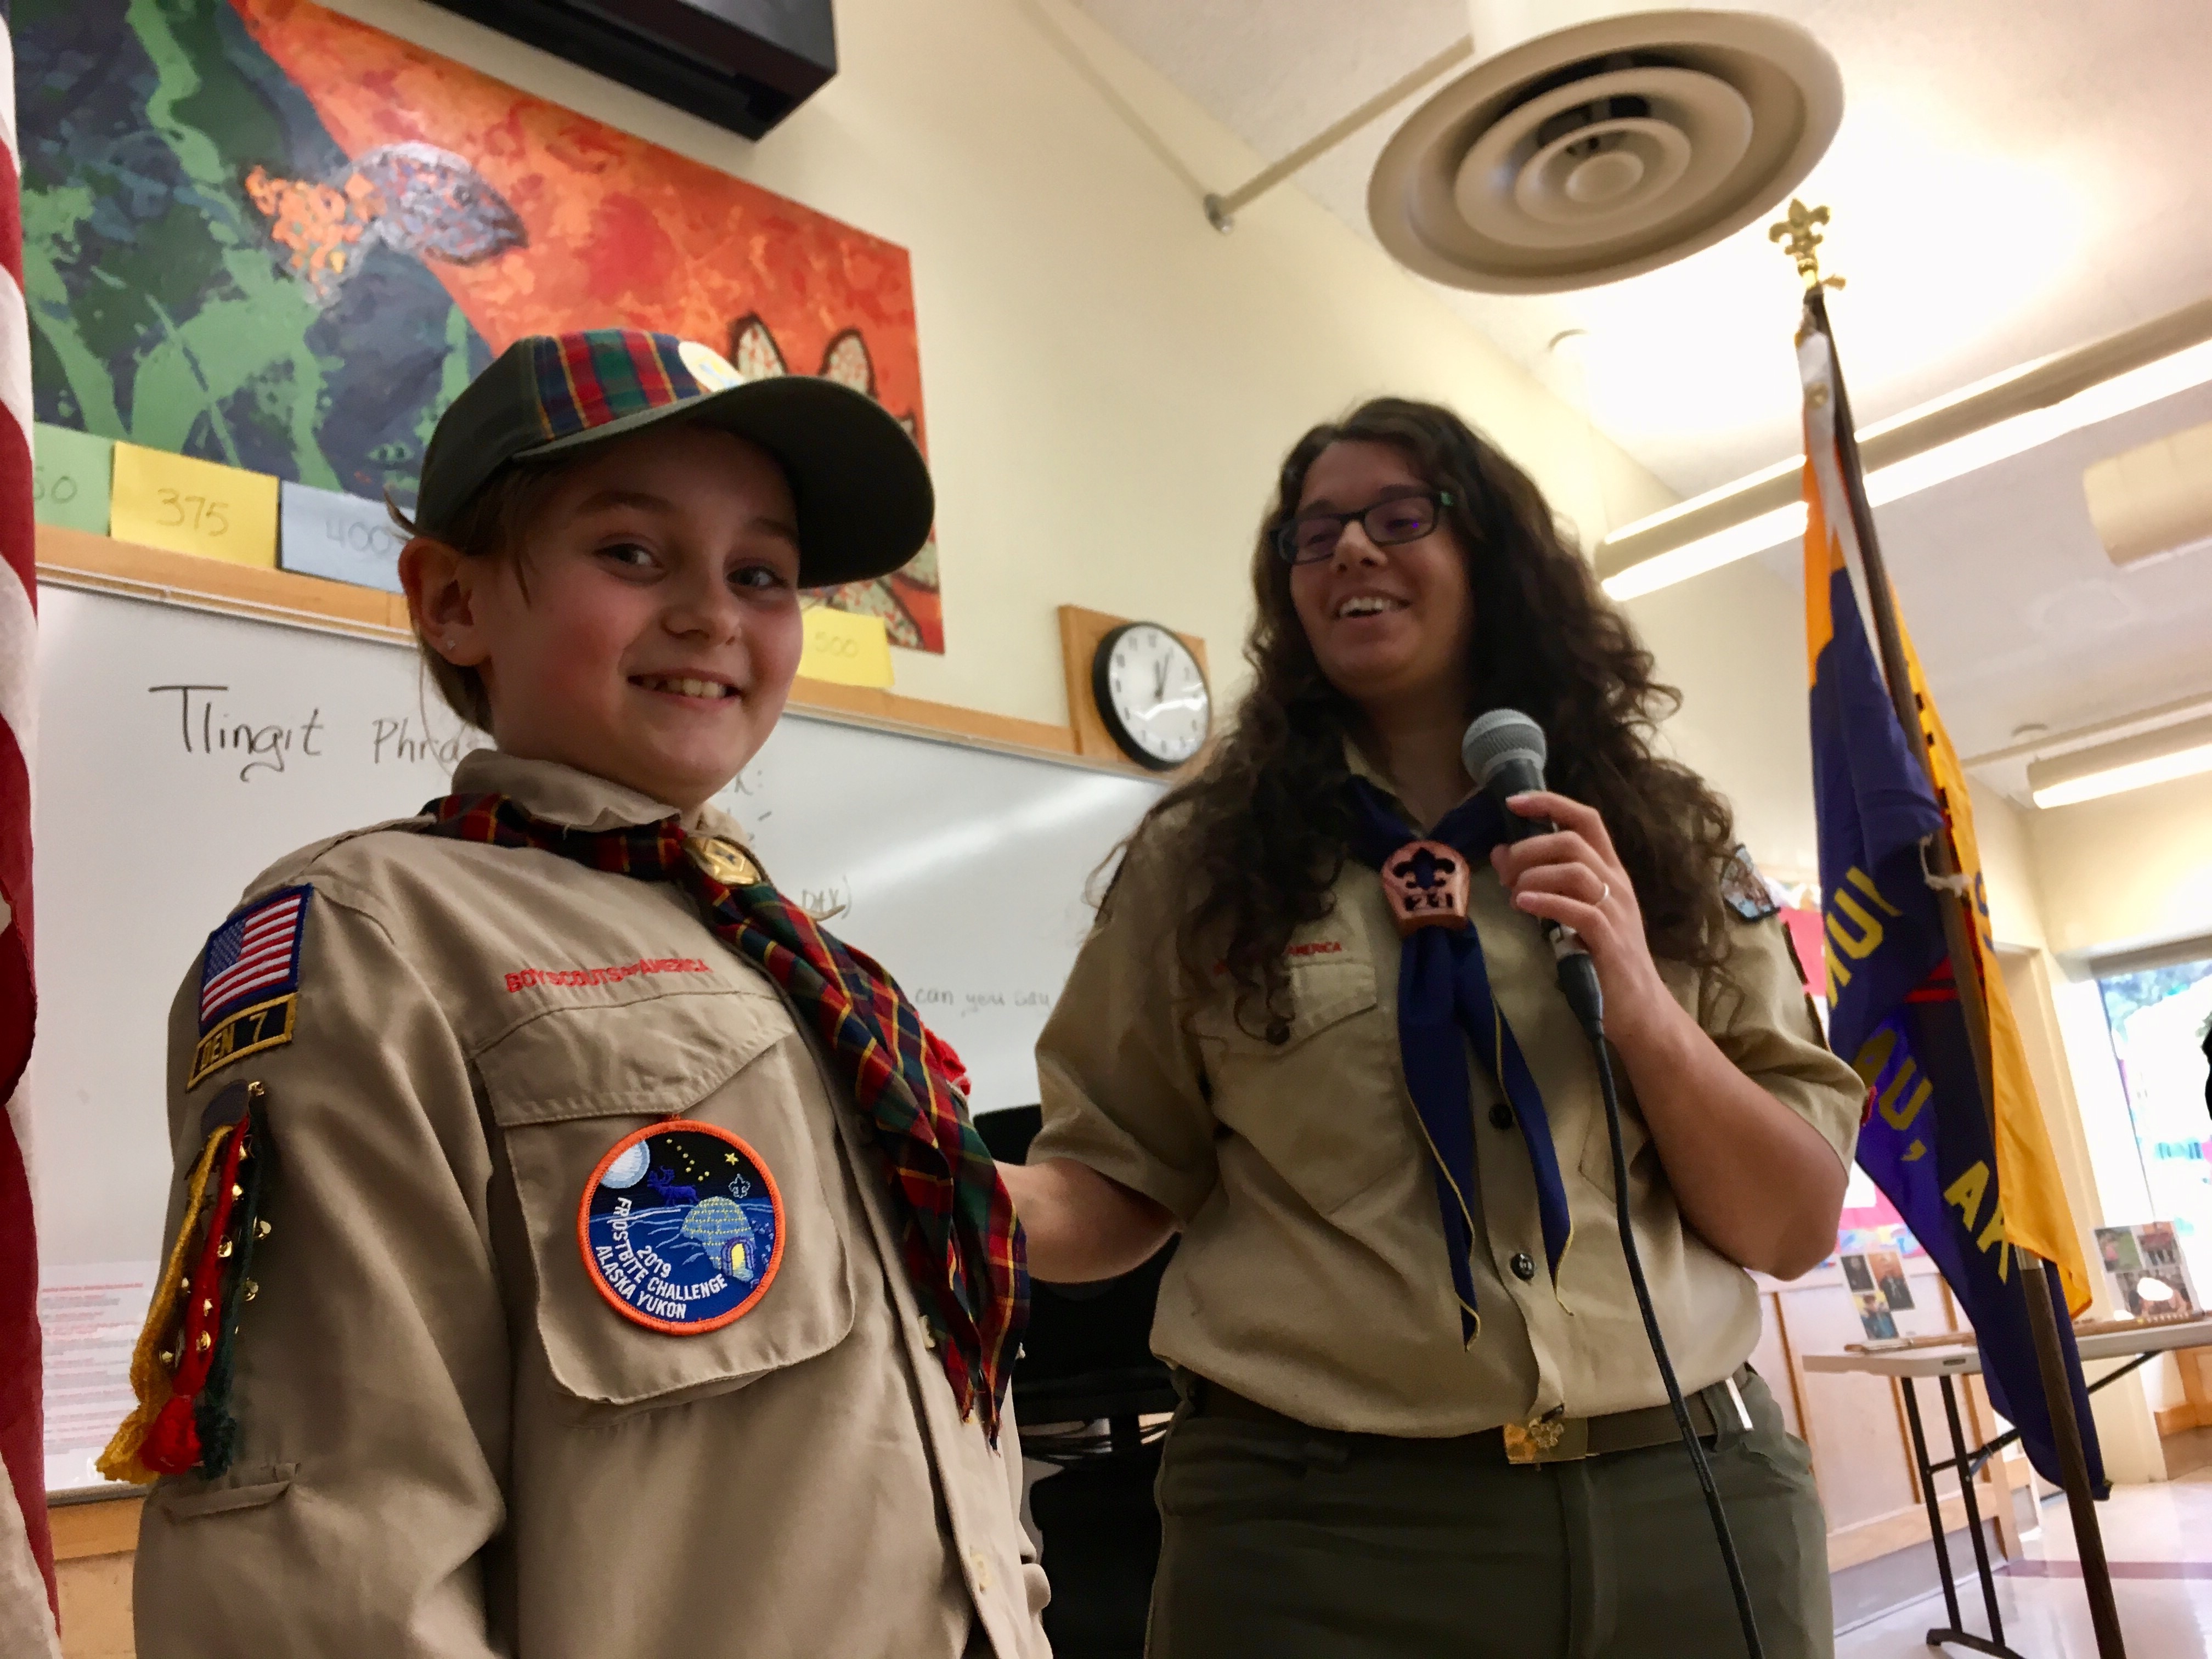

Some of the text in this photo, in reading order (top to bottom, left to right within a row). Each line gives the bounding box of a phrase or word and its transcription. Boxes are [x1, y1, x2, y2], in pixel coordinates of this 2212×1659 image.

[156, 488, 229, 536] 375
[326, 520, 392, 555] 400
[815, 631, 860, 658] 500
[148, 684, 481, 783] Tlingit Phra
[504, 968, 545, 992] BOY
[545, 966, 624, 987] SCOUTS
[915, 988, 954, 1006] can
[961, 992, 1005, 1018] you
[201, 1011, 268, 1070] DEN 7
[612, 1197, 728, 1301] FROSTBITE CHALLENGE
[636, 1245, 672, 1278] 2019
[595, 1246, 687, 1319] ALASKA YUKON
